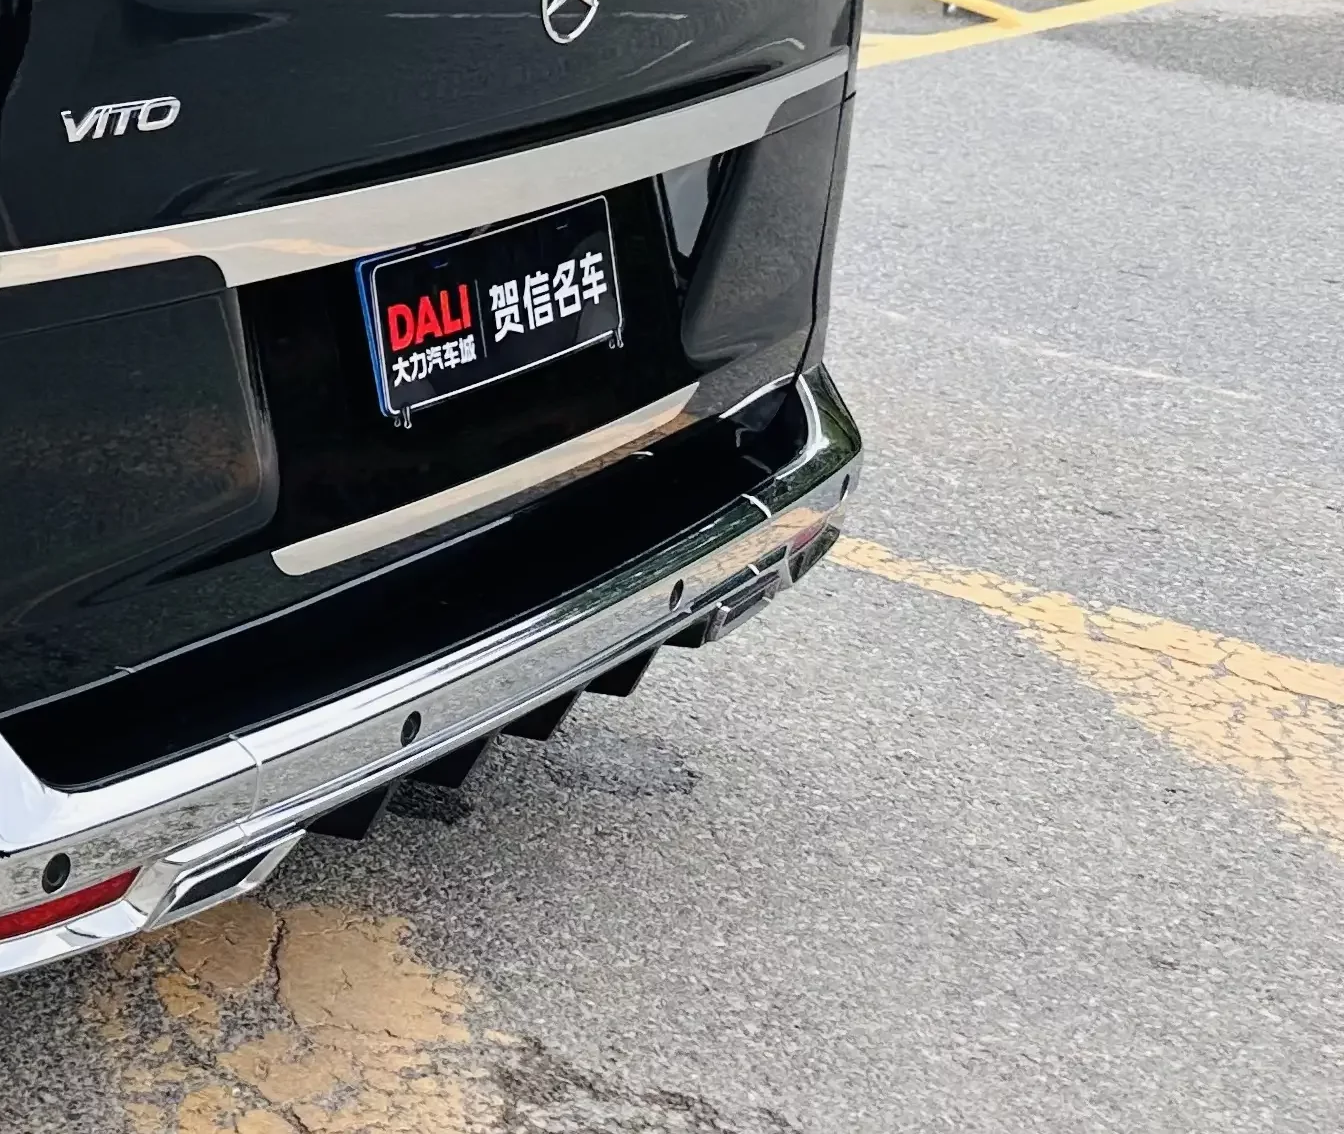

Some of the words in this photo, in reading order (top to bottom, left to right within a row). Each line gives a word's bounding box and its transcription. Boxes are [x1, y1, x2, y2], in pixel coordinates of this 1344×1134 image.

[61, 96, 181, 142] VITO
[387, 284, 472, 351] DALI
[489, 251, 608, 342] 贺信名车
[392, 334, 477, 387] 大力汽车城
